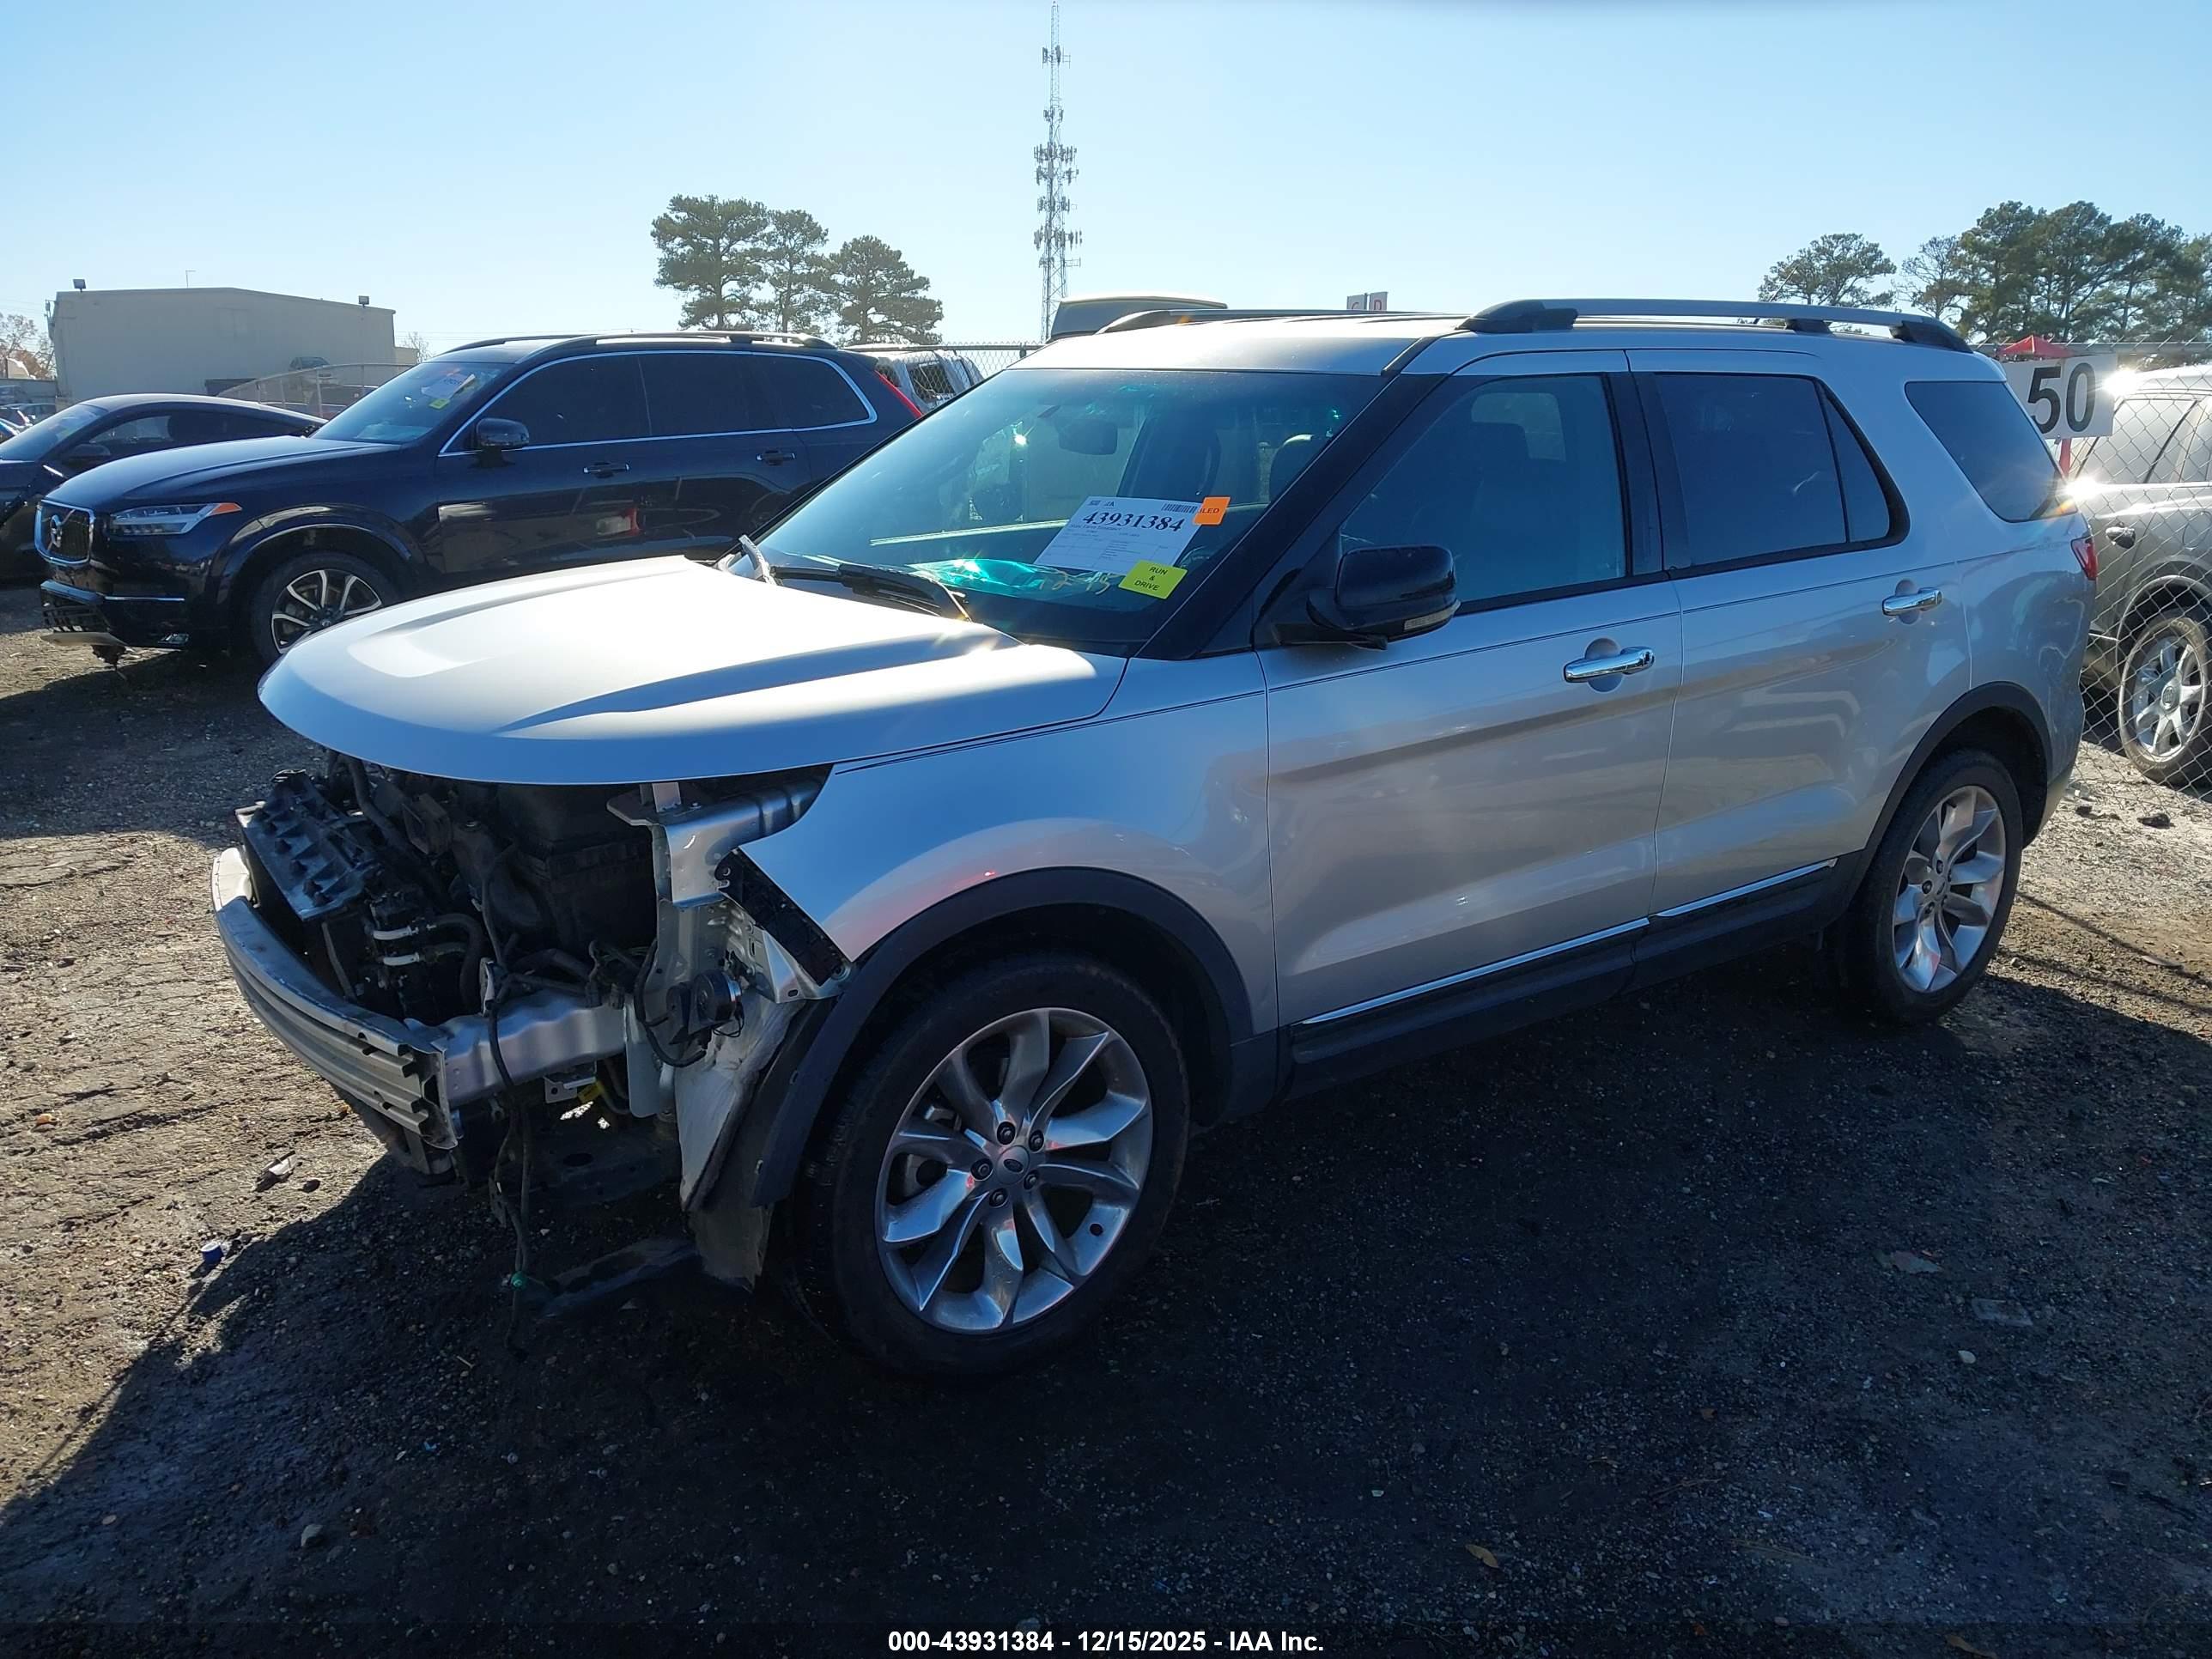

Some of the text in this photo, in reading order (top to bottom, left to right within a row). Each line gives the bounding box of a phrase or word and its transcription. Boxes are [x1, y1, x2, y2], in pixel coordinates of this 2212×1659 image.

[2027, 362, 2096, 434] 50
[1082, 511, 1186, 532] 43931384
[1149, 566, 1168, 575] RUN
[1134, 580, 1160, 592] DRIVE
